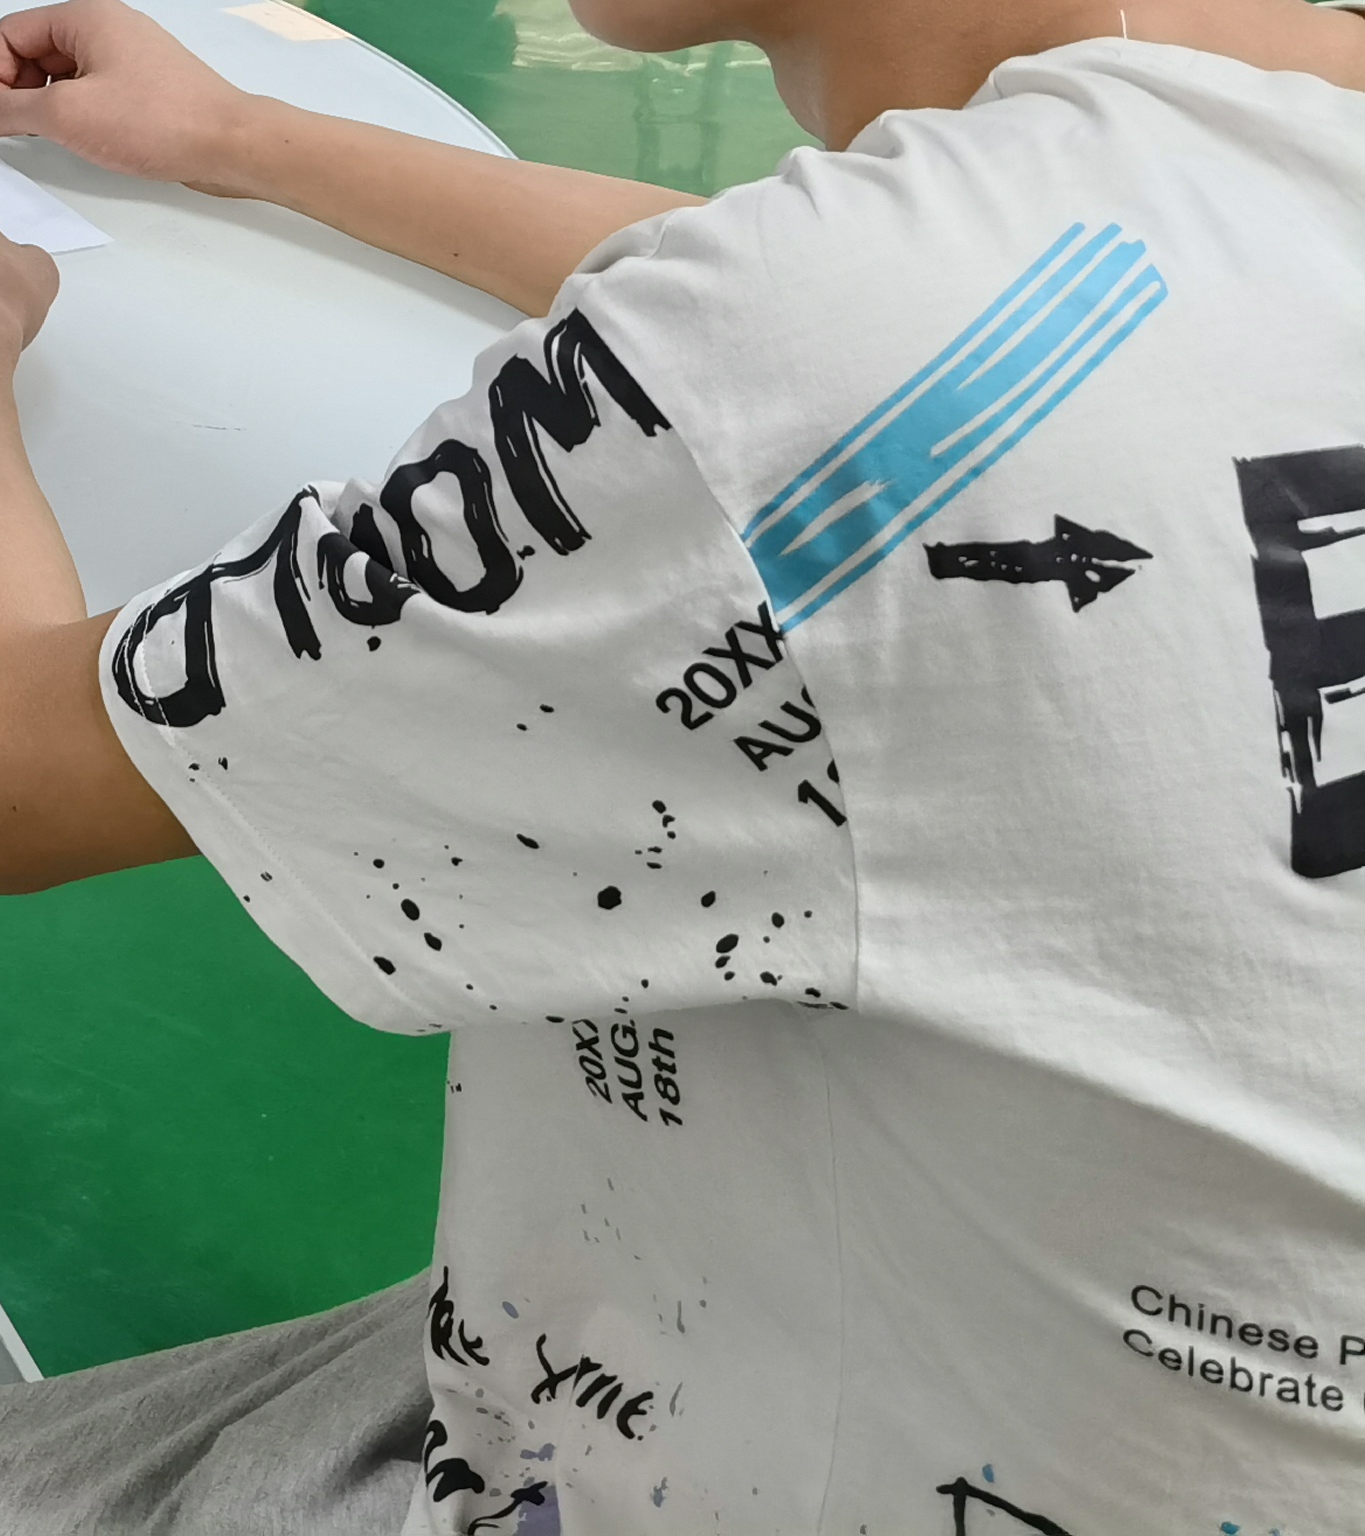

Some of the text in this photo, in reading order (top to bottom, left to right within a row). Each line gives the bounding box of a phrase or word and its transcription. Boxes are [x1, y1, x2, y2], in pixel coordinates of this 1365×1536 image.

[655, 600, 785, 731] 20XX
[732, 684, 823, 772] AU
[648, 1028, 683, 1127] 18th
[1131, 1284, 1319, 1360] Chinese
[1123, 1329, 1344, 1412] Celebrate
